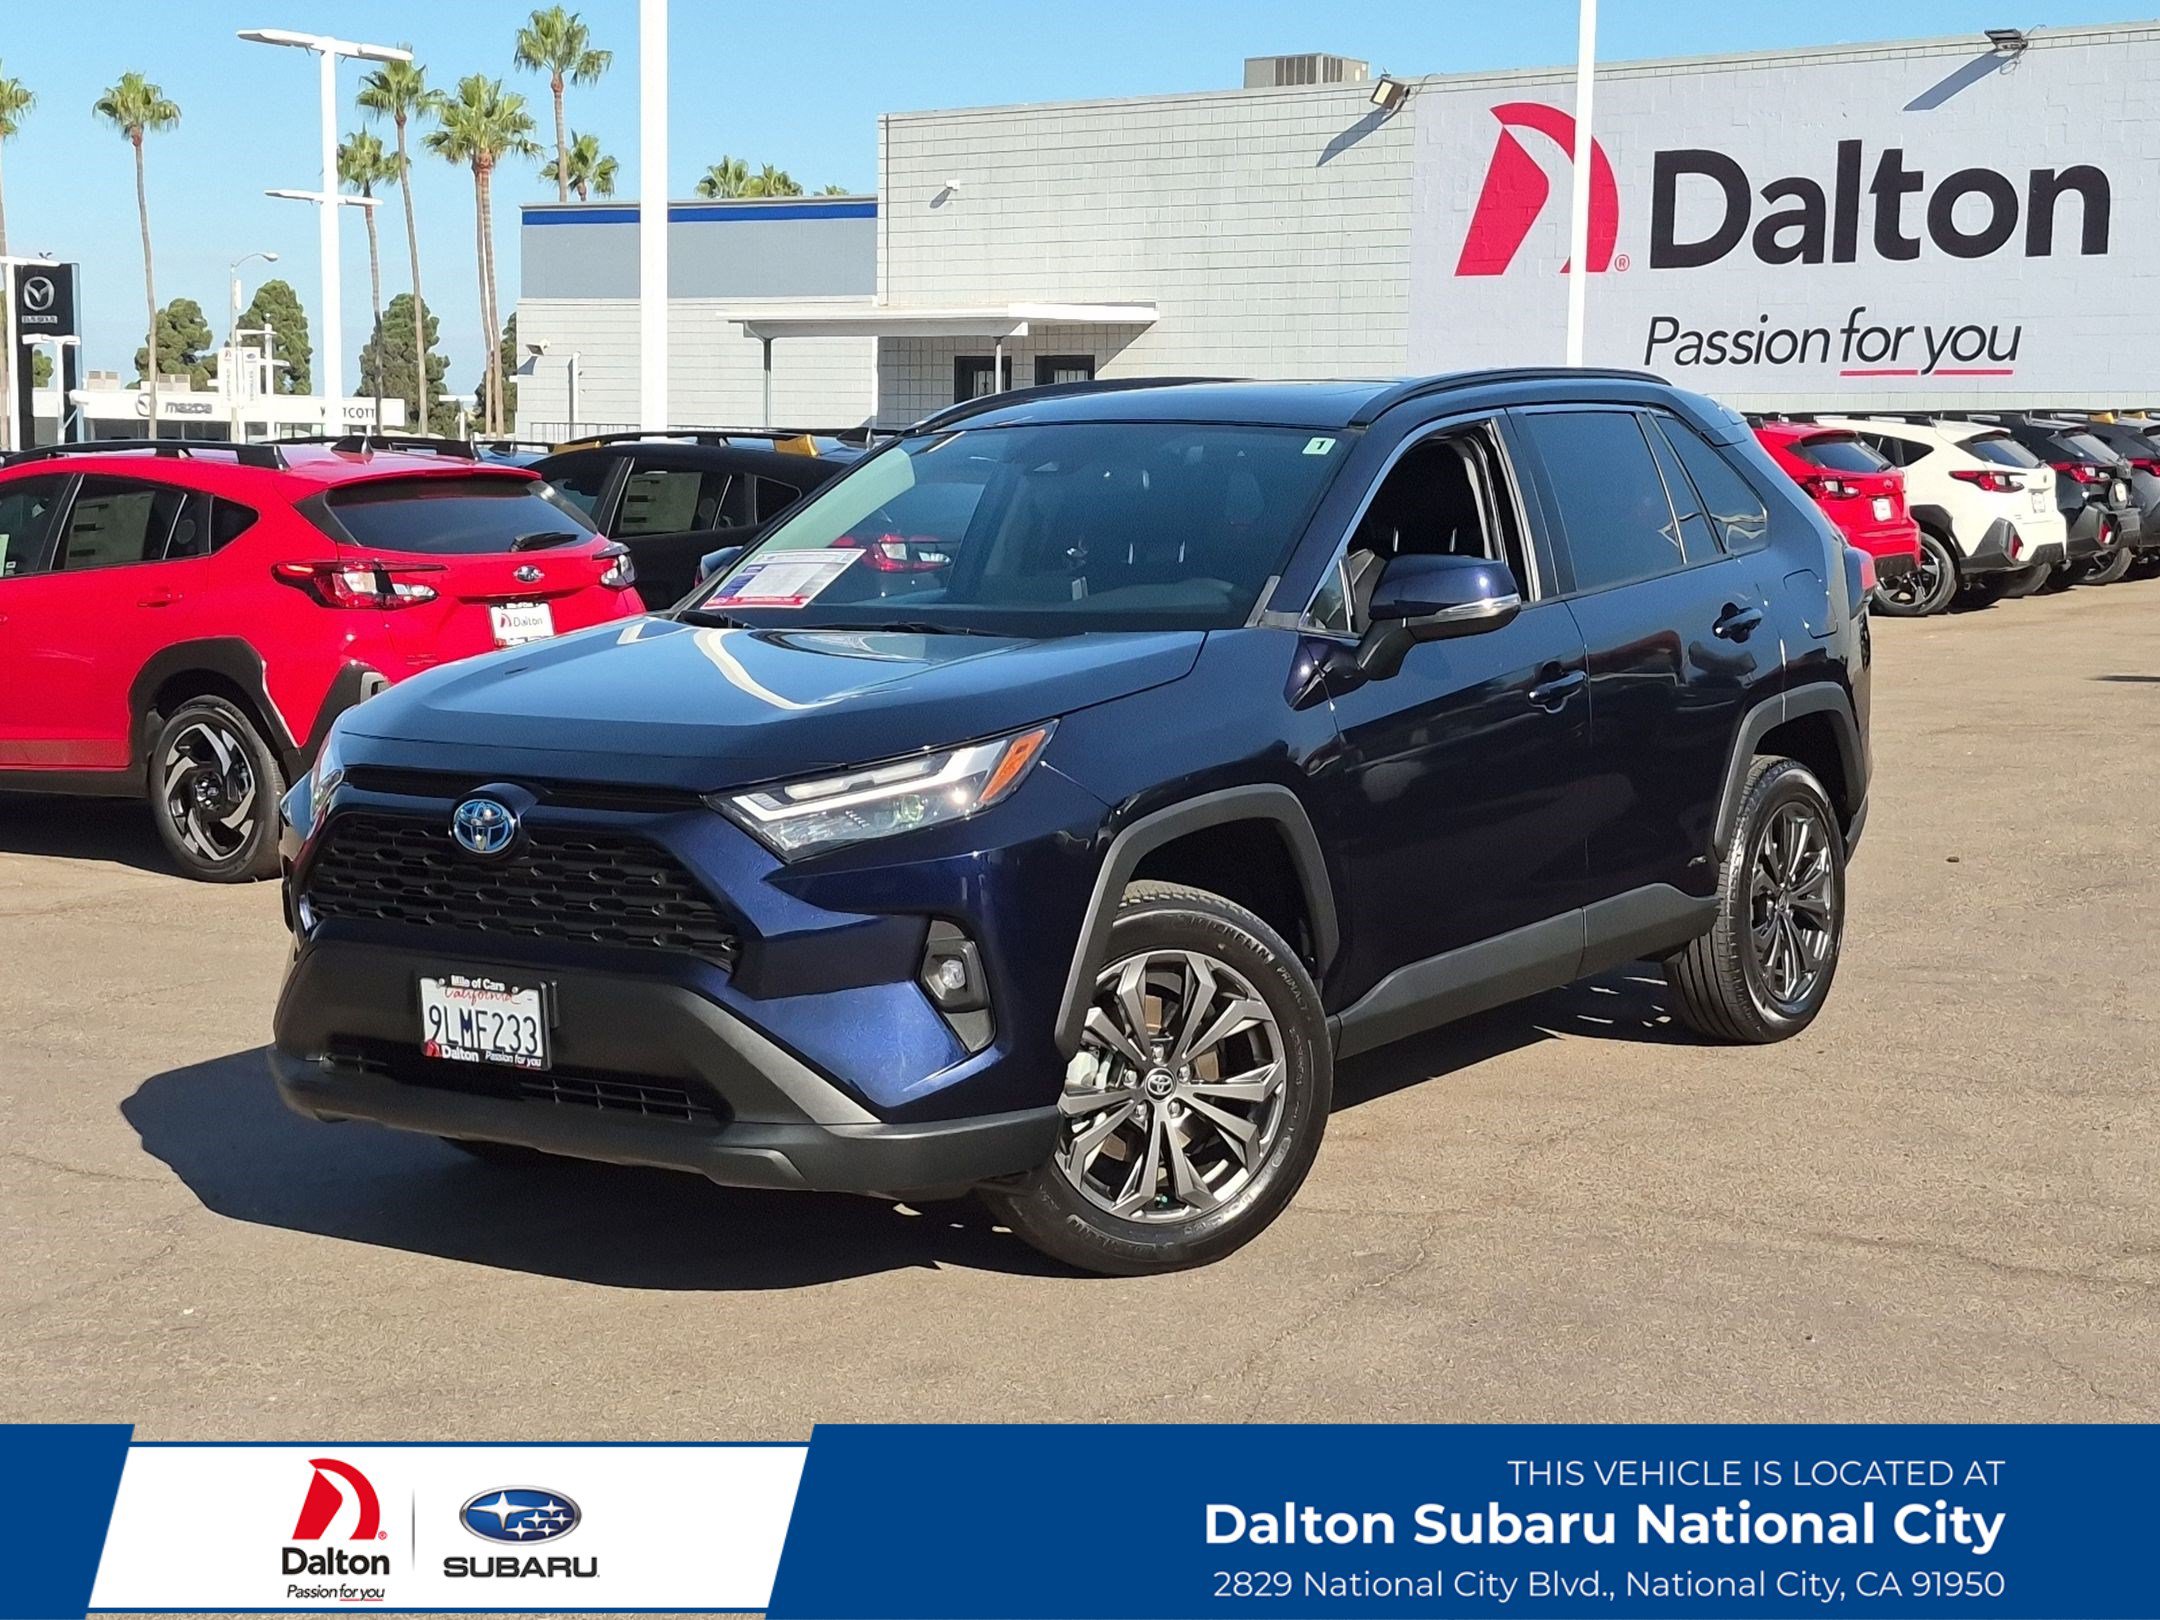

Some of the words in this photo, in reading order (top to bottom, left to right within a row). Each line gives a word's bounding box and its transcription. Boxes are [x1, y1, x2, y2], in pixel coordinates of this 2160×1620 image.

[1649, 139, 2111, 269] Dalton
[1644, 313, 1831, 366] Passion
[1839, 306, 1914, 371] for
[1921, 325, 2022, 375] you
[164, 401, 213, 414] mazda
[320, 406, 375, 419] WTCOTT
[513, 616, 543, 627] Dalton
[451, 975, 470, 988] Mile
[471, 978, 482, 989] of
[482, 978, 505, 992] Cars
[444, 987, 521, 1006] California
[428, 1004, 538, 1055] 9LMF233
[441, 1045, 479, 1062] Dalton
[485, 1050, 513, 1063] Passion
[514, 1053, 527, 1065] for
[526, 1056, 541, 1067] you
